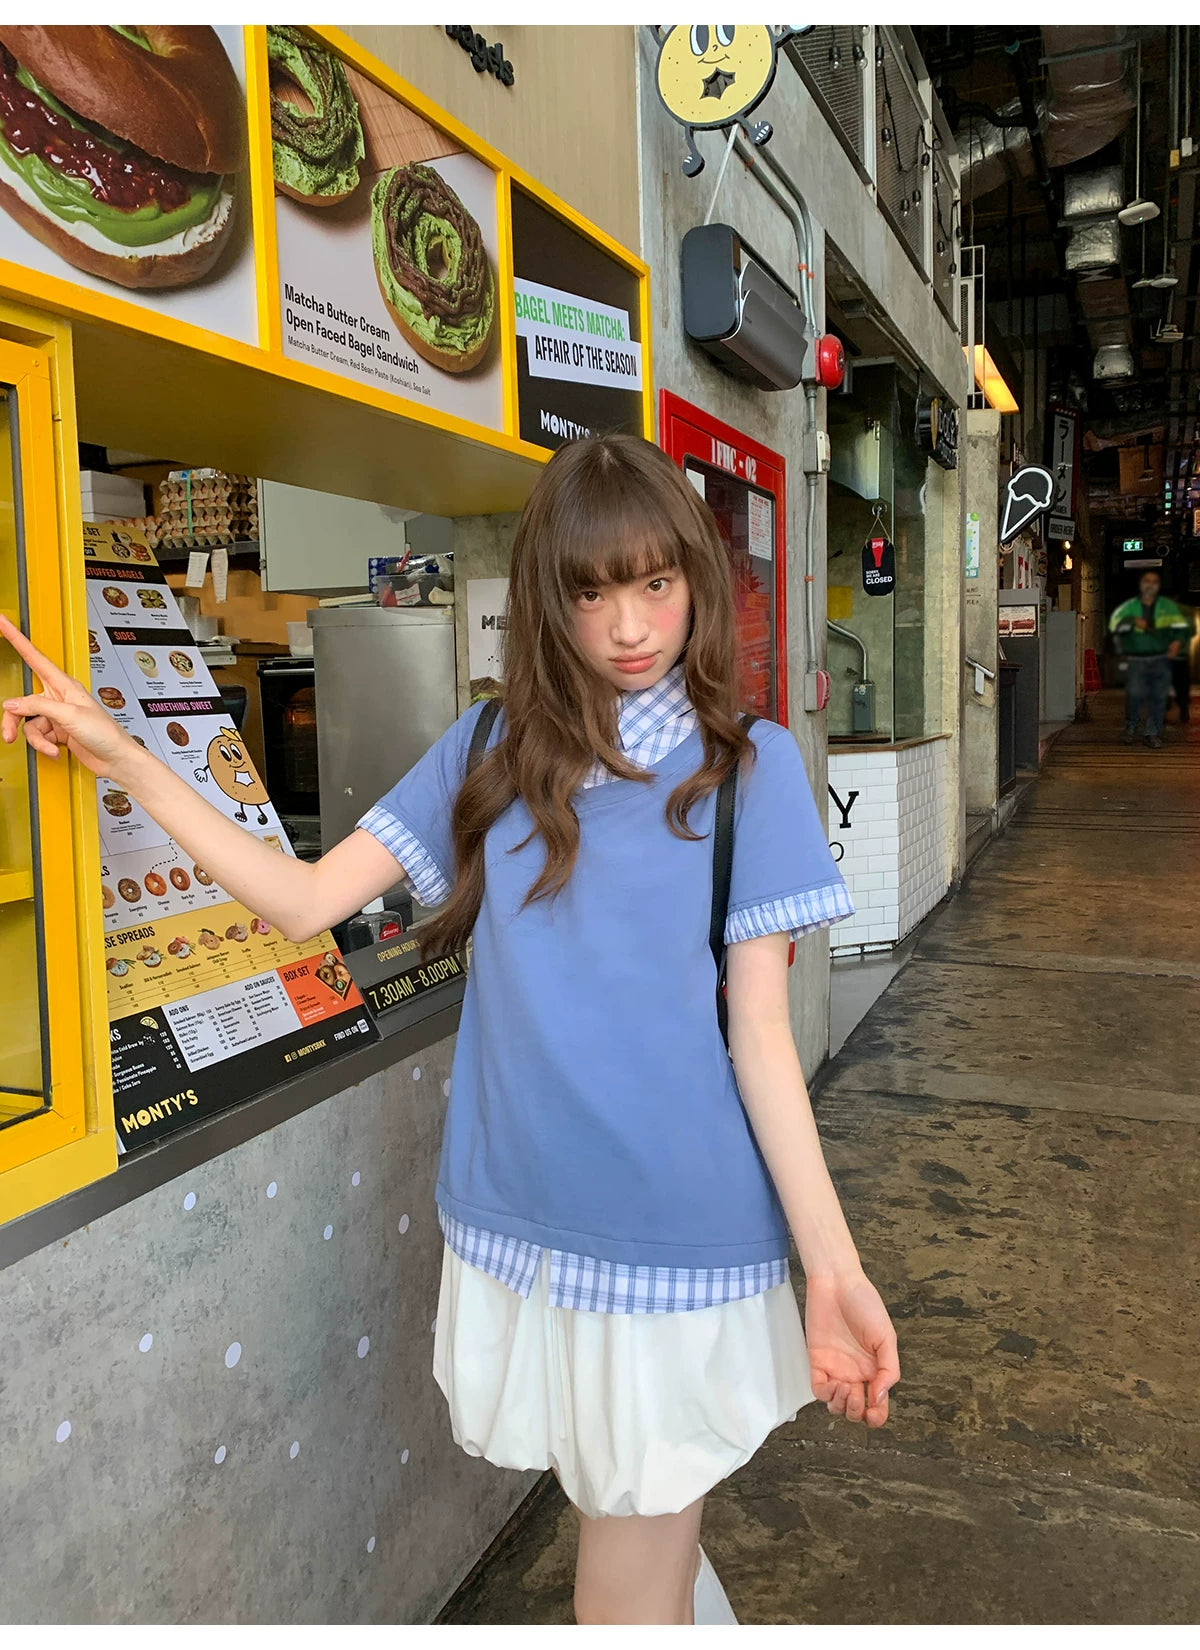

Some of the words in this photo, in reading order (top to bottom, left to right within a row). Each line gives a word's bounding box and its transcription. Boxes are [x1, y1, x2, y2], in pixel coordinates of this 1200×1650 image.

[285, 283, 325, 315] Matcha
[327, 302, 358, 328] Butter
[360, 316, 390, 342] Cream
[514, 291, 551, 324] BAGEL
[552, 301, 585, 332] MEETS
[586, 311, 626, 341] MATCHA:
[286, 308, 314, 331] Open
[316, 320, 346, 346] Faced
[348, 333, 375, 358] Bagel
[377, 345, 419, 374] Sandwich
[535, 335, 571, 364] AFFAIR
[572, 341, 584, 367] OF
[586, 345, 604, 370] THE
[605, 350, 637, 376] SEASON
[287, 335, 310, 352] Matcha
[311, 344, 329, 358] Butter
[330, 352, 349, 367] Cream,
[350, 359, 360, 370] Red
[361, 363, 374, 375] Bean
[375, 368, 388, 380] Paste
[413, 382, 421, 392] Sea
[422, 386, 431, 396] Salt
[745, 456, 757, 482] 02
[116, 569, 145, 580] BAGELS
[866, 576, 893, 585] CLOSED
[113, 631, 137, 641] SIDES
[147, 702, 191, 713] SOMETHING
[191, 701, 213, 711] SWEET
[117, 926, 156, 945] SPREADS
[377, 946, 403, 962] OPENING
[283, 971, 298, 983] BOX
[298, 965, 310, 977] SET
[244, 983, 254, 991] ADD
[260, 976, 275, 986] SAUCES
[168, 1008, 179, 1016] ADD
[179, 1005, 190, 1013] ONS
[333, 1031, 346, 1041] FIND
[344, 1028, 352, 1036] US
[121, 1089, 199, 1134] MONTY'S
